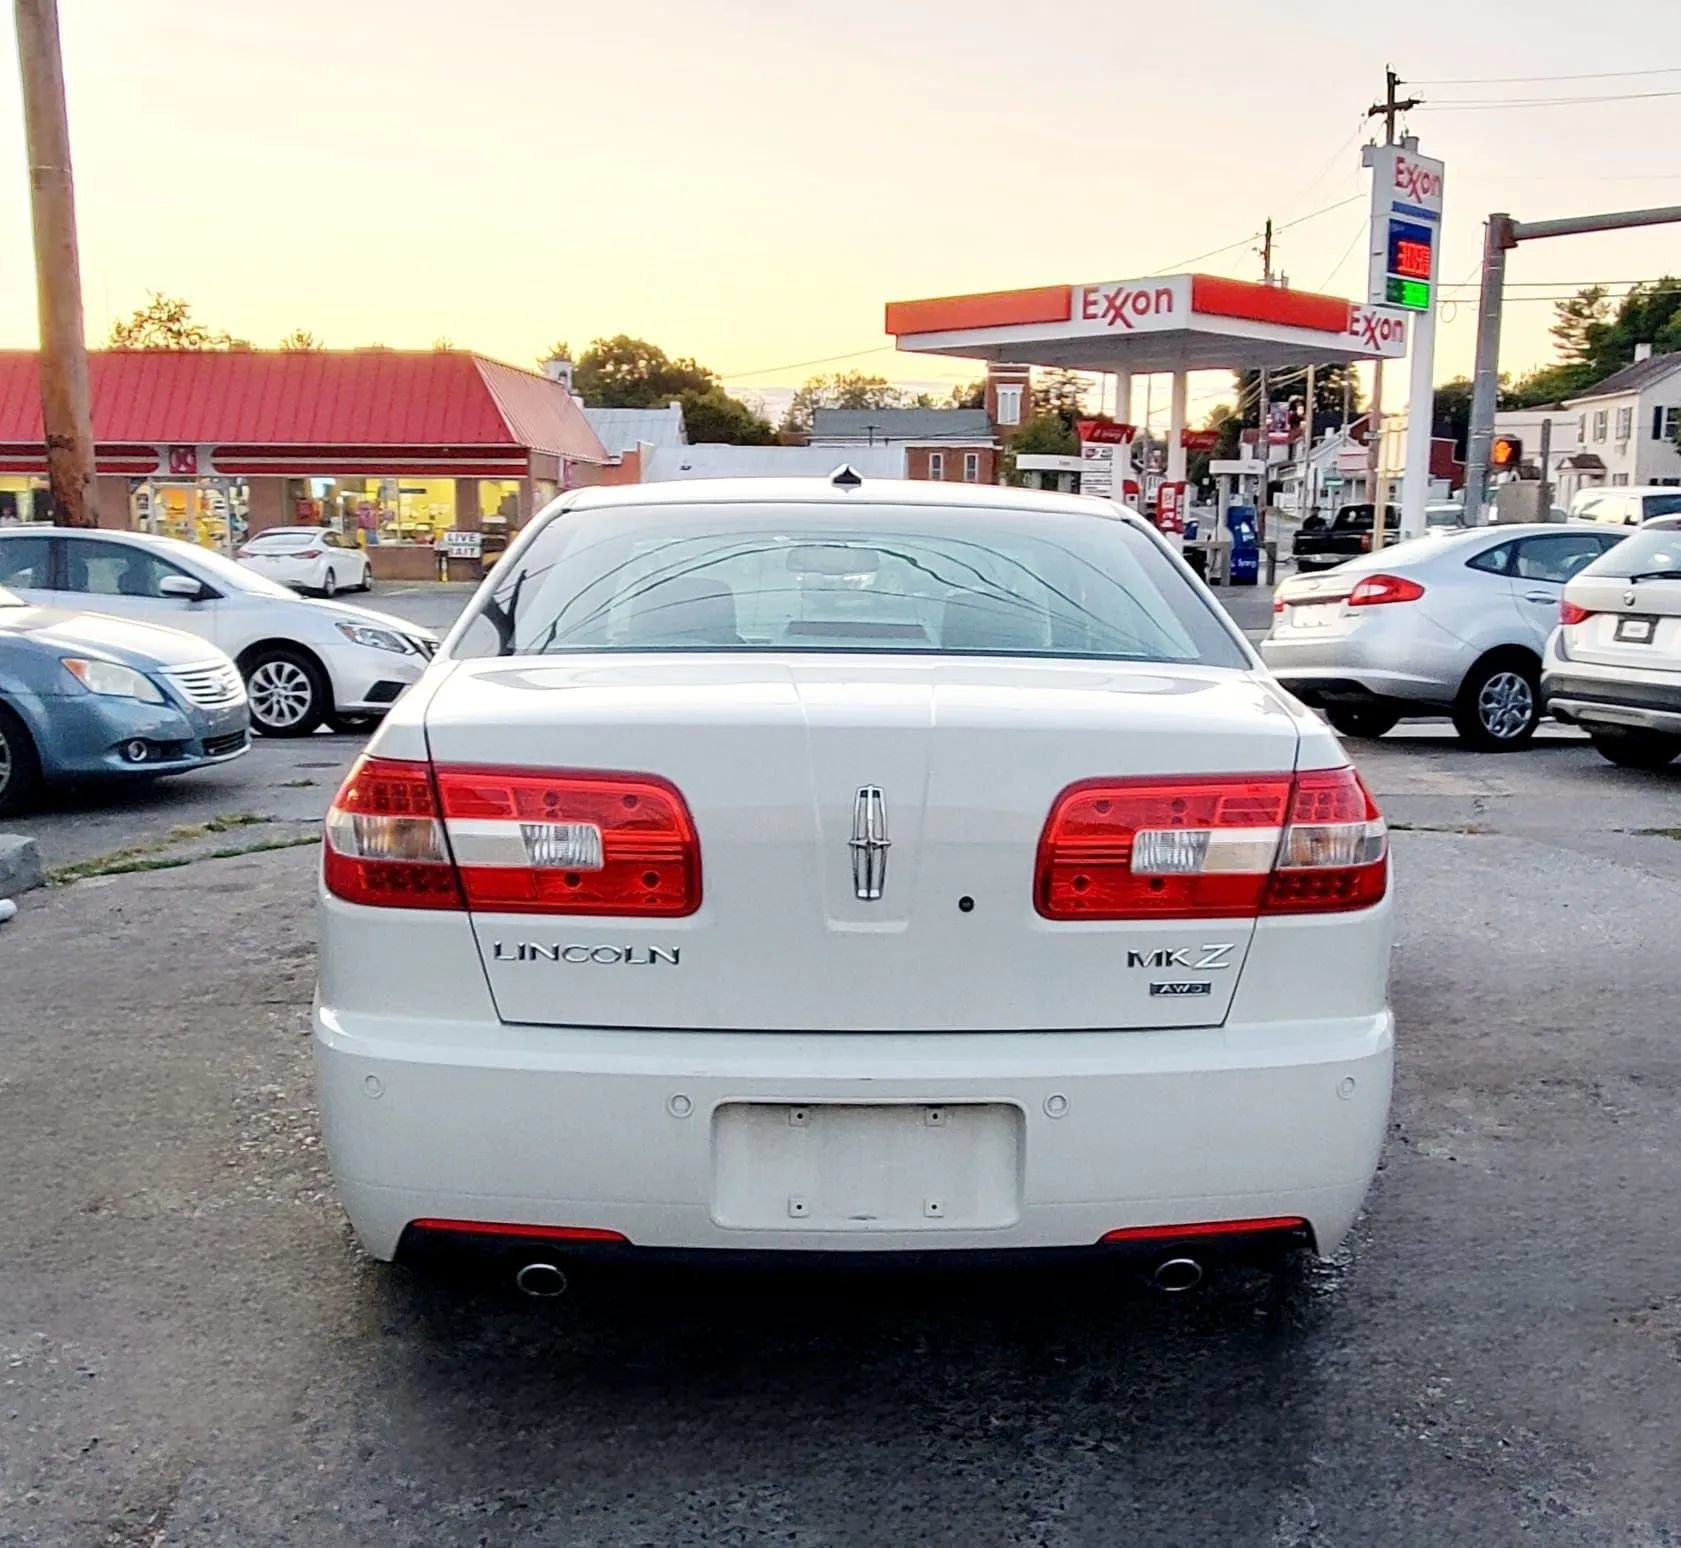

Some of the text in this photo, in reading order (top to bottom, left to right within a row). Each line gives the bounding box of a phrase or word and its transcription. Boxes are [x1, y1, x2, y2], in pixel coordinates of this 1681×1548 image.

[1394, 156, 1441, 203] Exxon
[1082, 287, 1173, 328] Exxon
[1349, 305, 1404, 351] Exxon
[447, 533, 476, 542] LIVE
[493, 941, 680, 965] LINCOLN
[1159, 984, 1202, 993] AWD
